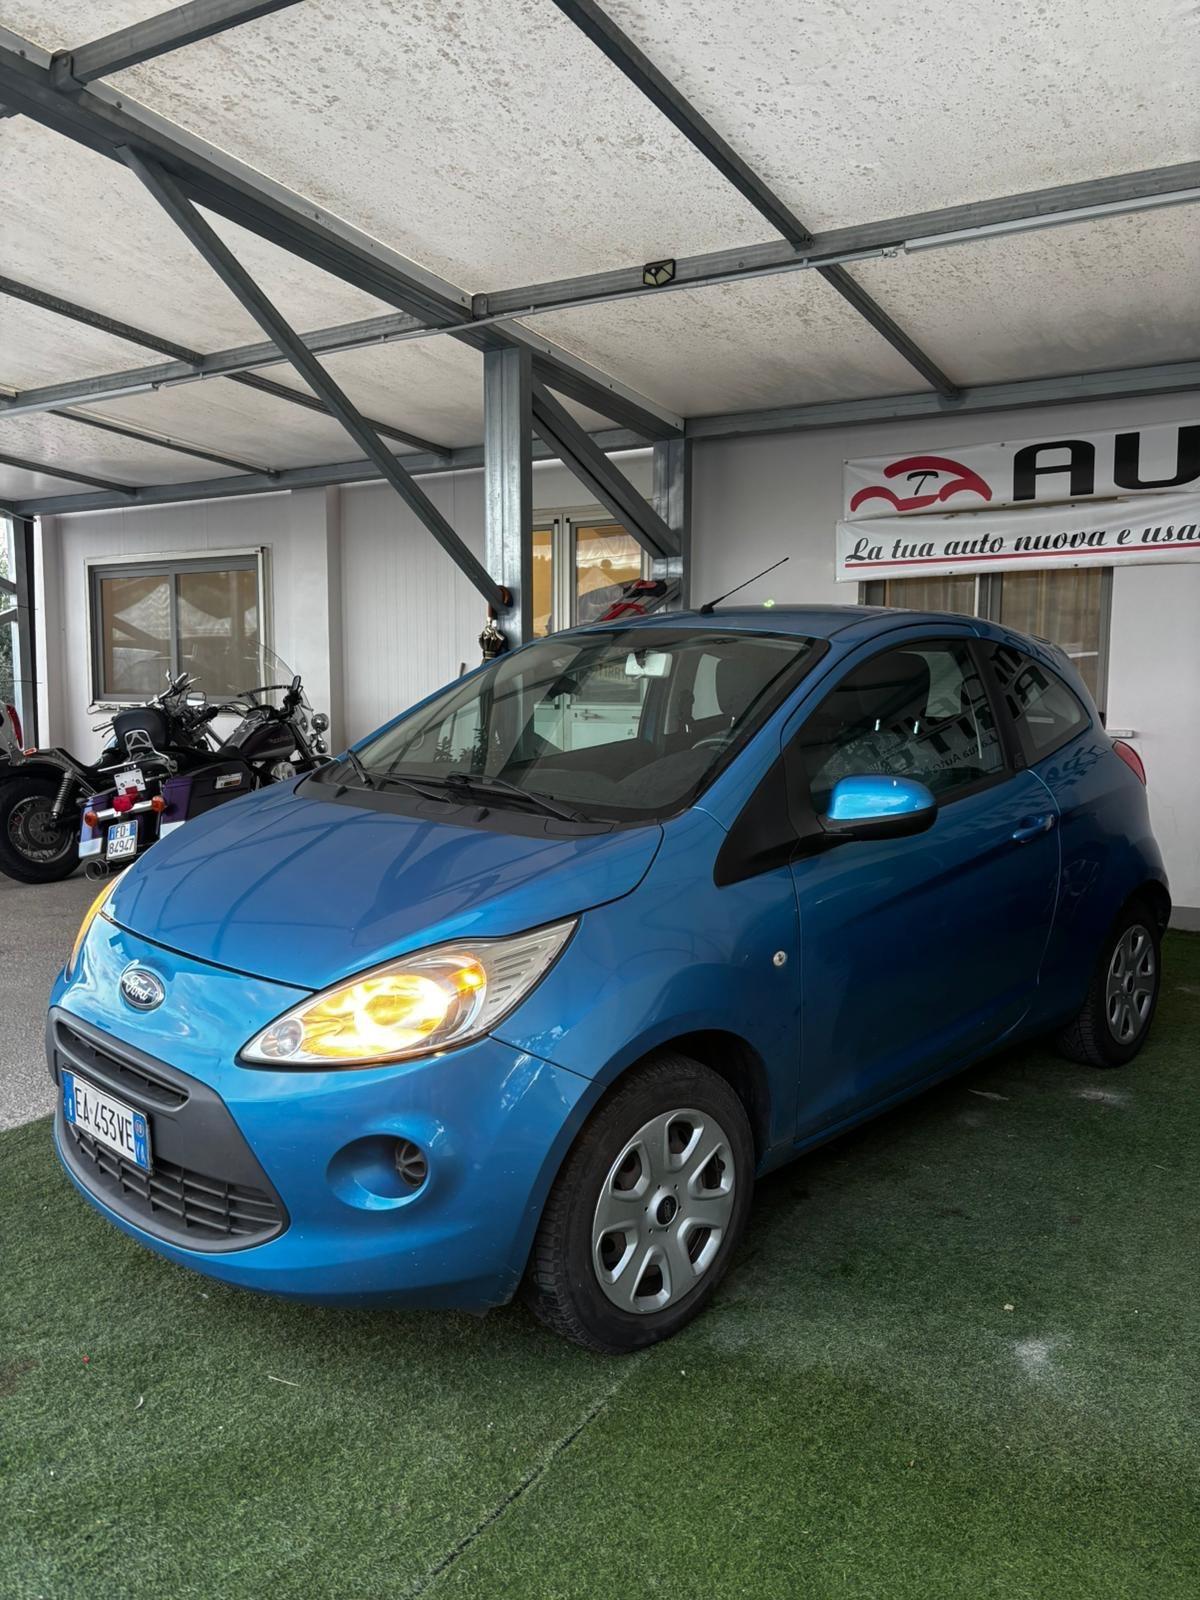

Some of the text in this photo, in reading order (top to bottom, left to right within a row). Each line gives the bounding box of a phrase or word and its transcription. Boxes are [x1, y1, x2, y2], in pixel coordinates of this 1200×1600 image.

[1012, 426, 1200, 501] AU
[845, 537, 883, 562] La
[892, 539, 935, 559] tua
[944, 533, 1004, 556] auto
[1014, 527, 1106, 552] nuova
[1117, 527, 1130, 545] e
[109, 838, 134, 855] 84947
[124, 975, 153, 1001] Ford
